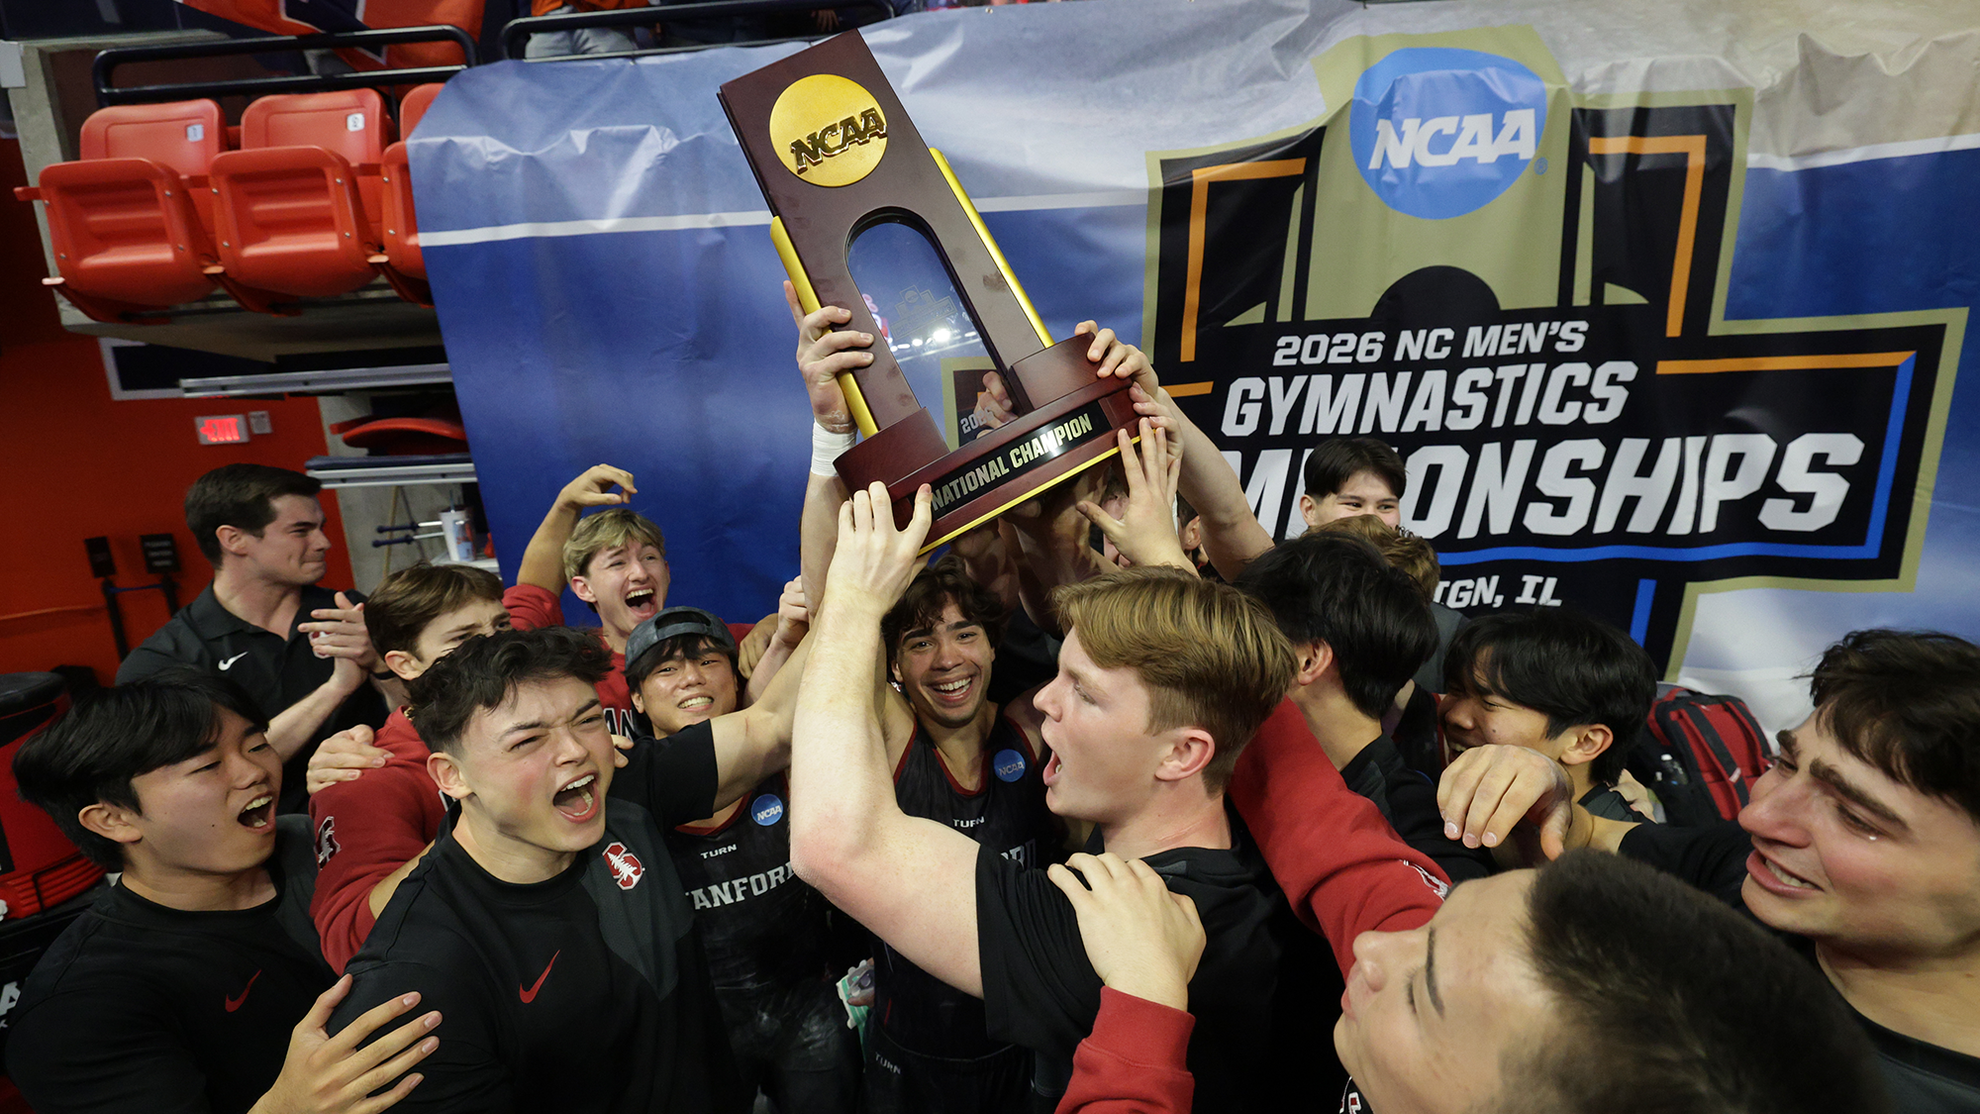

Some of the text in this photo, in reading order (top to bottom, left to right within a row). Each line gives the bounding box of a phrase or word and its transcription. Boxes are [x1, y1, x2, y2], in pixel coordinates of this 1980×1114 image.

[789, 107, 888, 175] NCAA
[1368, 108, 1536, 170] NCAA
[1272, 320, 1589, 366] 2026 NC MEN'S
[1221, 361, 1639, 437] GYMNASTICS
[931, 413, 1093, 511] NATIONAL CHAMPION
[1514, 574, 1563, 607] IL
[998, 761, 1025, 776] NCAA
[757, 805, 782, 821] NCAA
[700, 844, 738, 859] TURN
[685, 861, 795, 910] ANFOR
